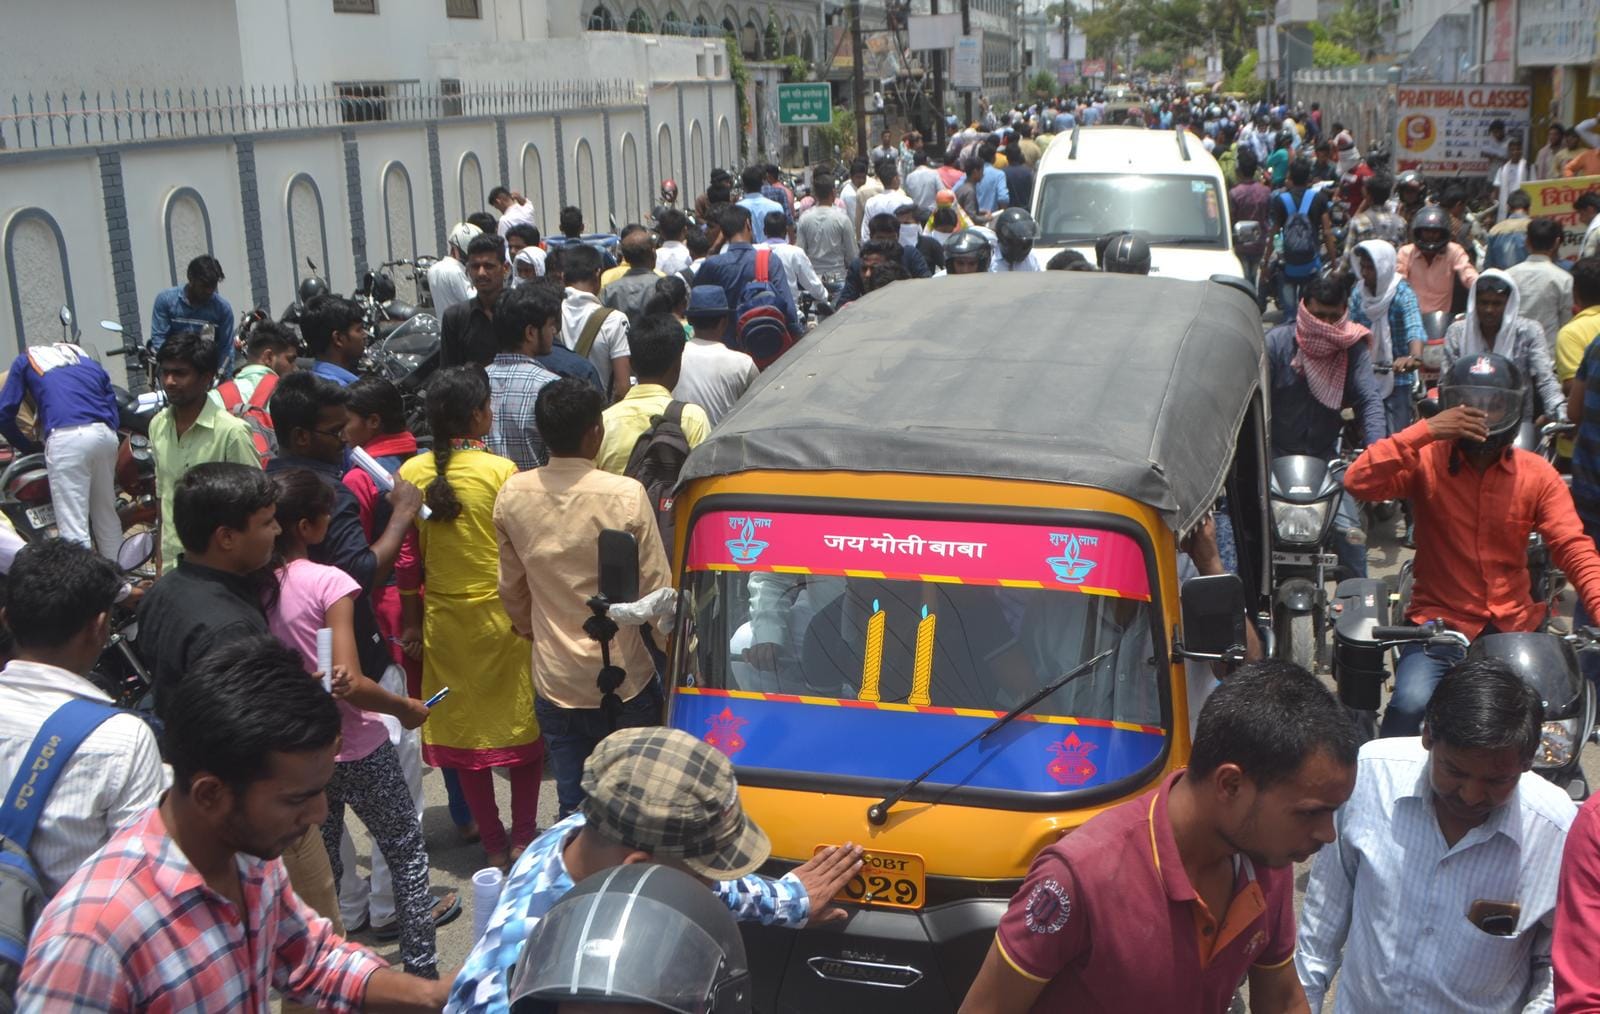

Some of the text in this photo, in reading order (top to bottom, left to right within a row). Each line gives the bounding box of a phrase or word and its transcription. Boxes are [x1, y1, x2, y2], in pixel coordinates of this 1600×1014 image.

[1398, 89, 1528, 109] PRATIBHA CLASSES
[823, 533, 988, 559] जय मोती बाबा
